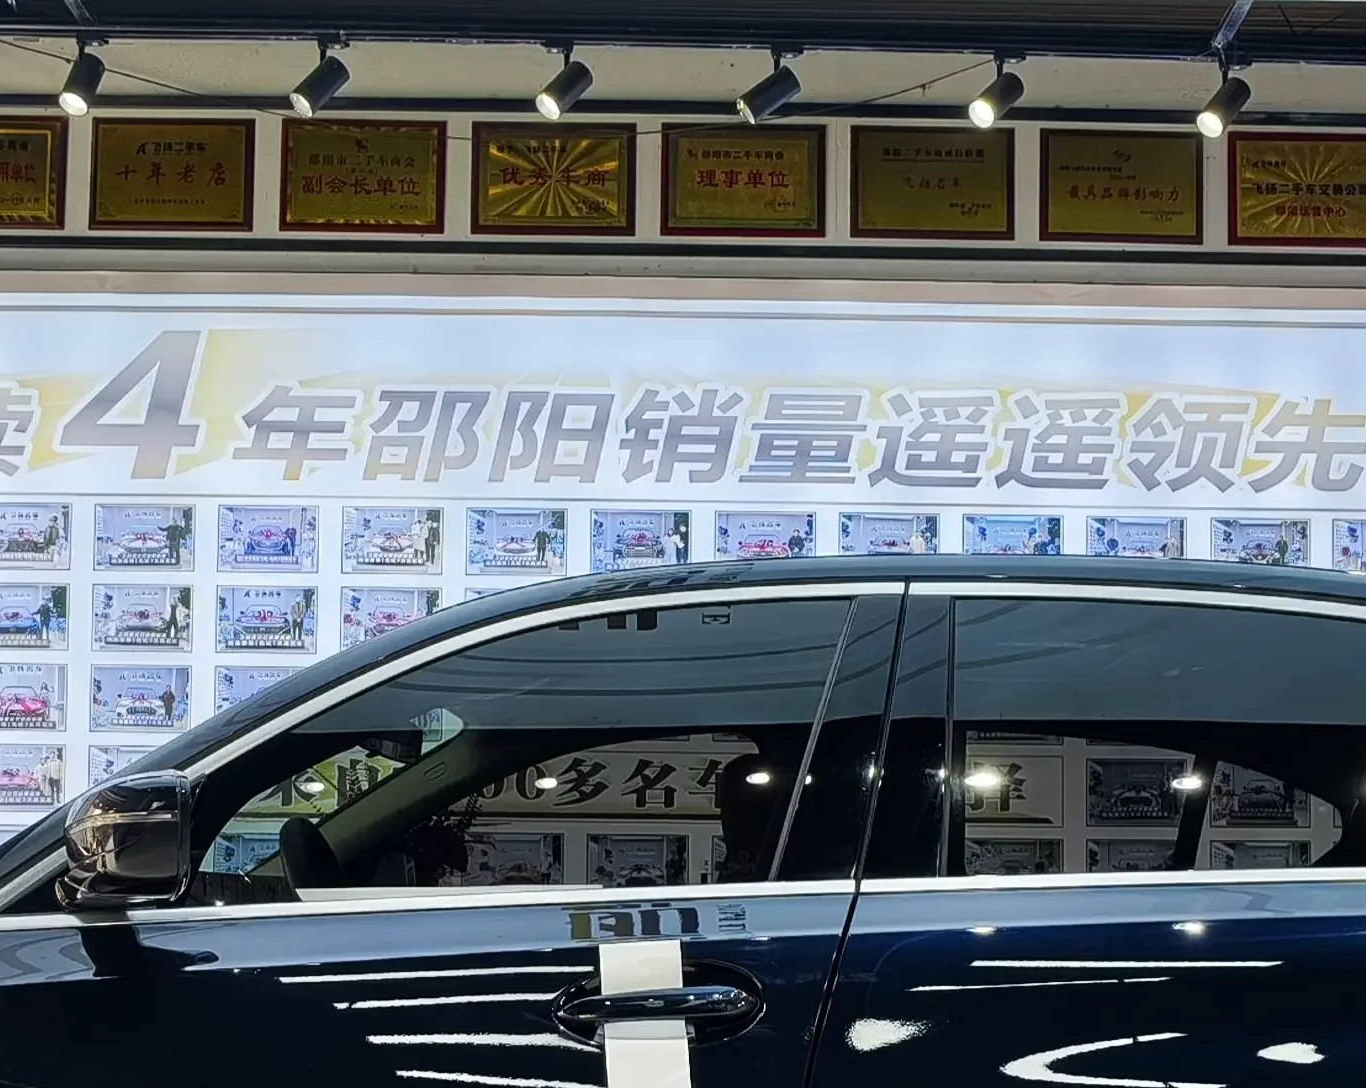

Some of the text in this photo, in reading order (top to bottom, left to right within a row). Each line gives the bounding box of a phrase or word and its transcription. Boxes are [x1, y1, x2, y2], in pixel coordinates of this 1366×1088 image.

[116, 160, 227, 187] 十年老店
[500, 167, 610, 187] 优秀车商
[696, 166, 790, 188] 理事单位
[302, 174, 422, 196] 副会长单位
